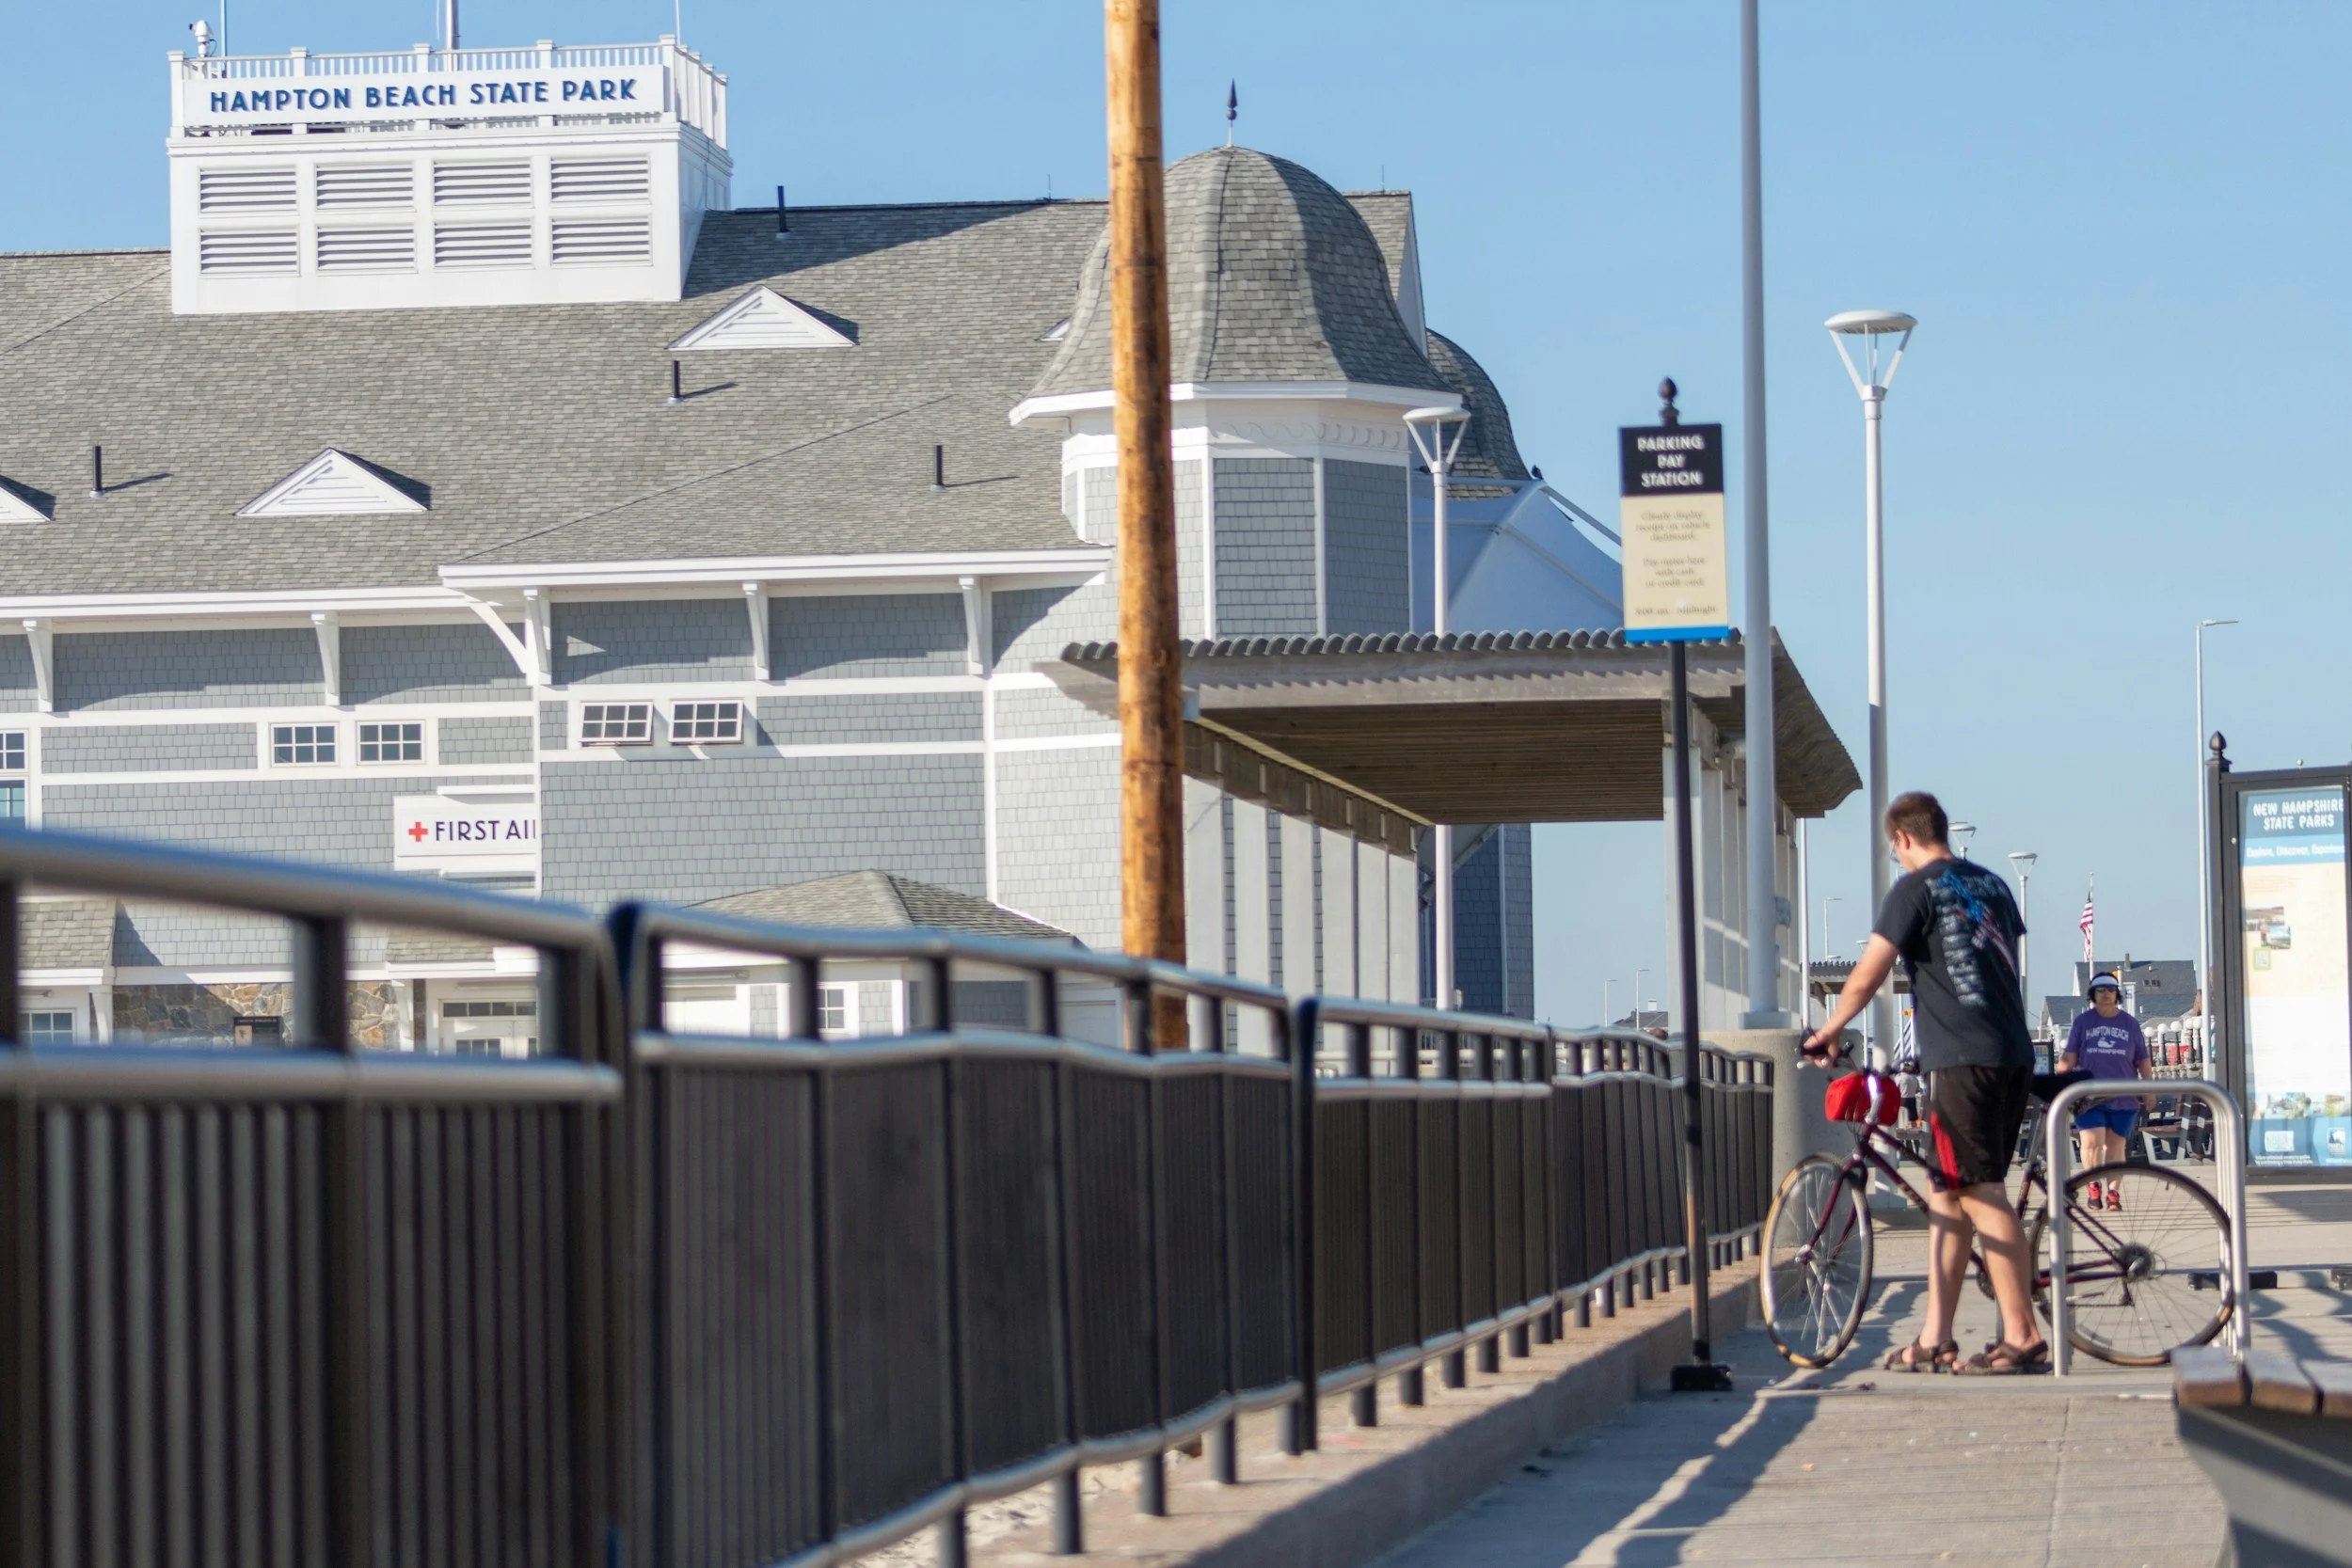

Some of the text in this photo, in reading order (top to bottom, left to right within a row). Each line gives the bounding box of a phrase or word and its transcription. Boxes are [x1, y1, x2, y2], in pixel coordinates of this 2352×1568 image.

[210, 78, 638, 113] HAMPTON BEACH STATE PARK
[1637, 435, 1705, 451] PARKING
[1657, 453, 1686, 469] PAY
[1641, 470, 1703, 488] STATION
[2253, 798, 2344, 817] NEW HAMPSHIRE
[436, 819, 536, 841] FIRST AI
[2264, 814, 2335, 832] STATE PARKS
[2086, 1025, 2129, 1042] HAMPTON BEACH
[2099, 1048, 2126, 1056] HAMPSHIRE
